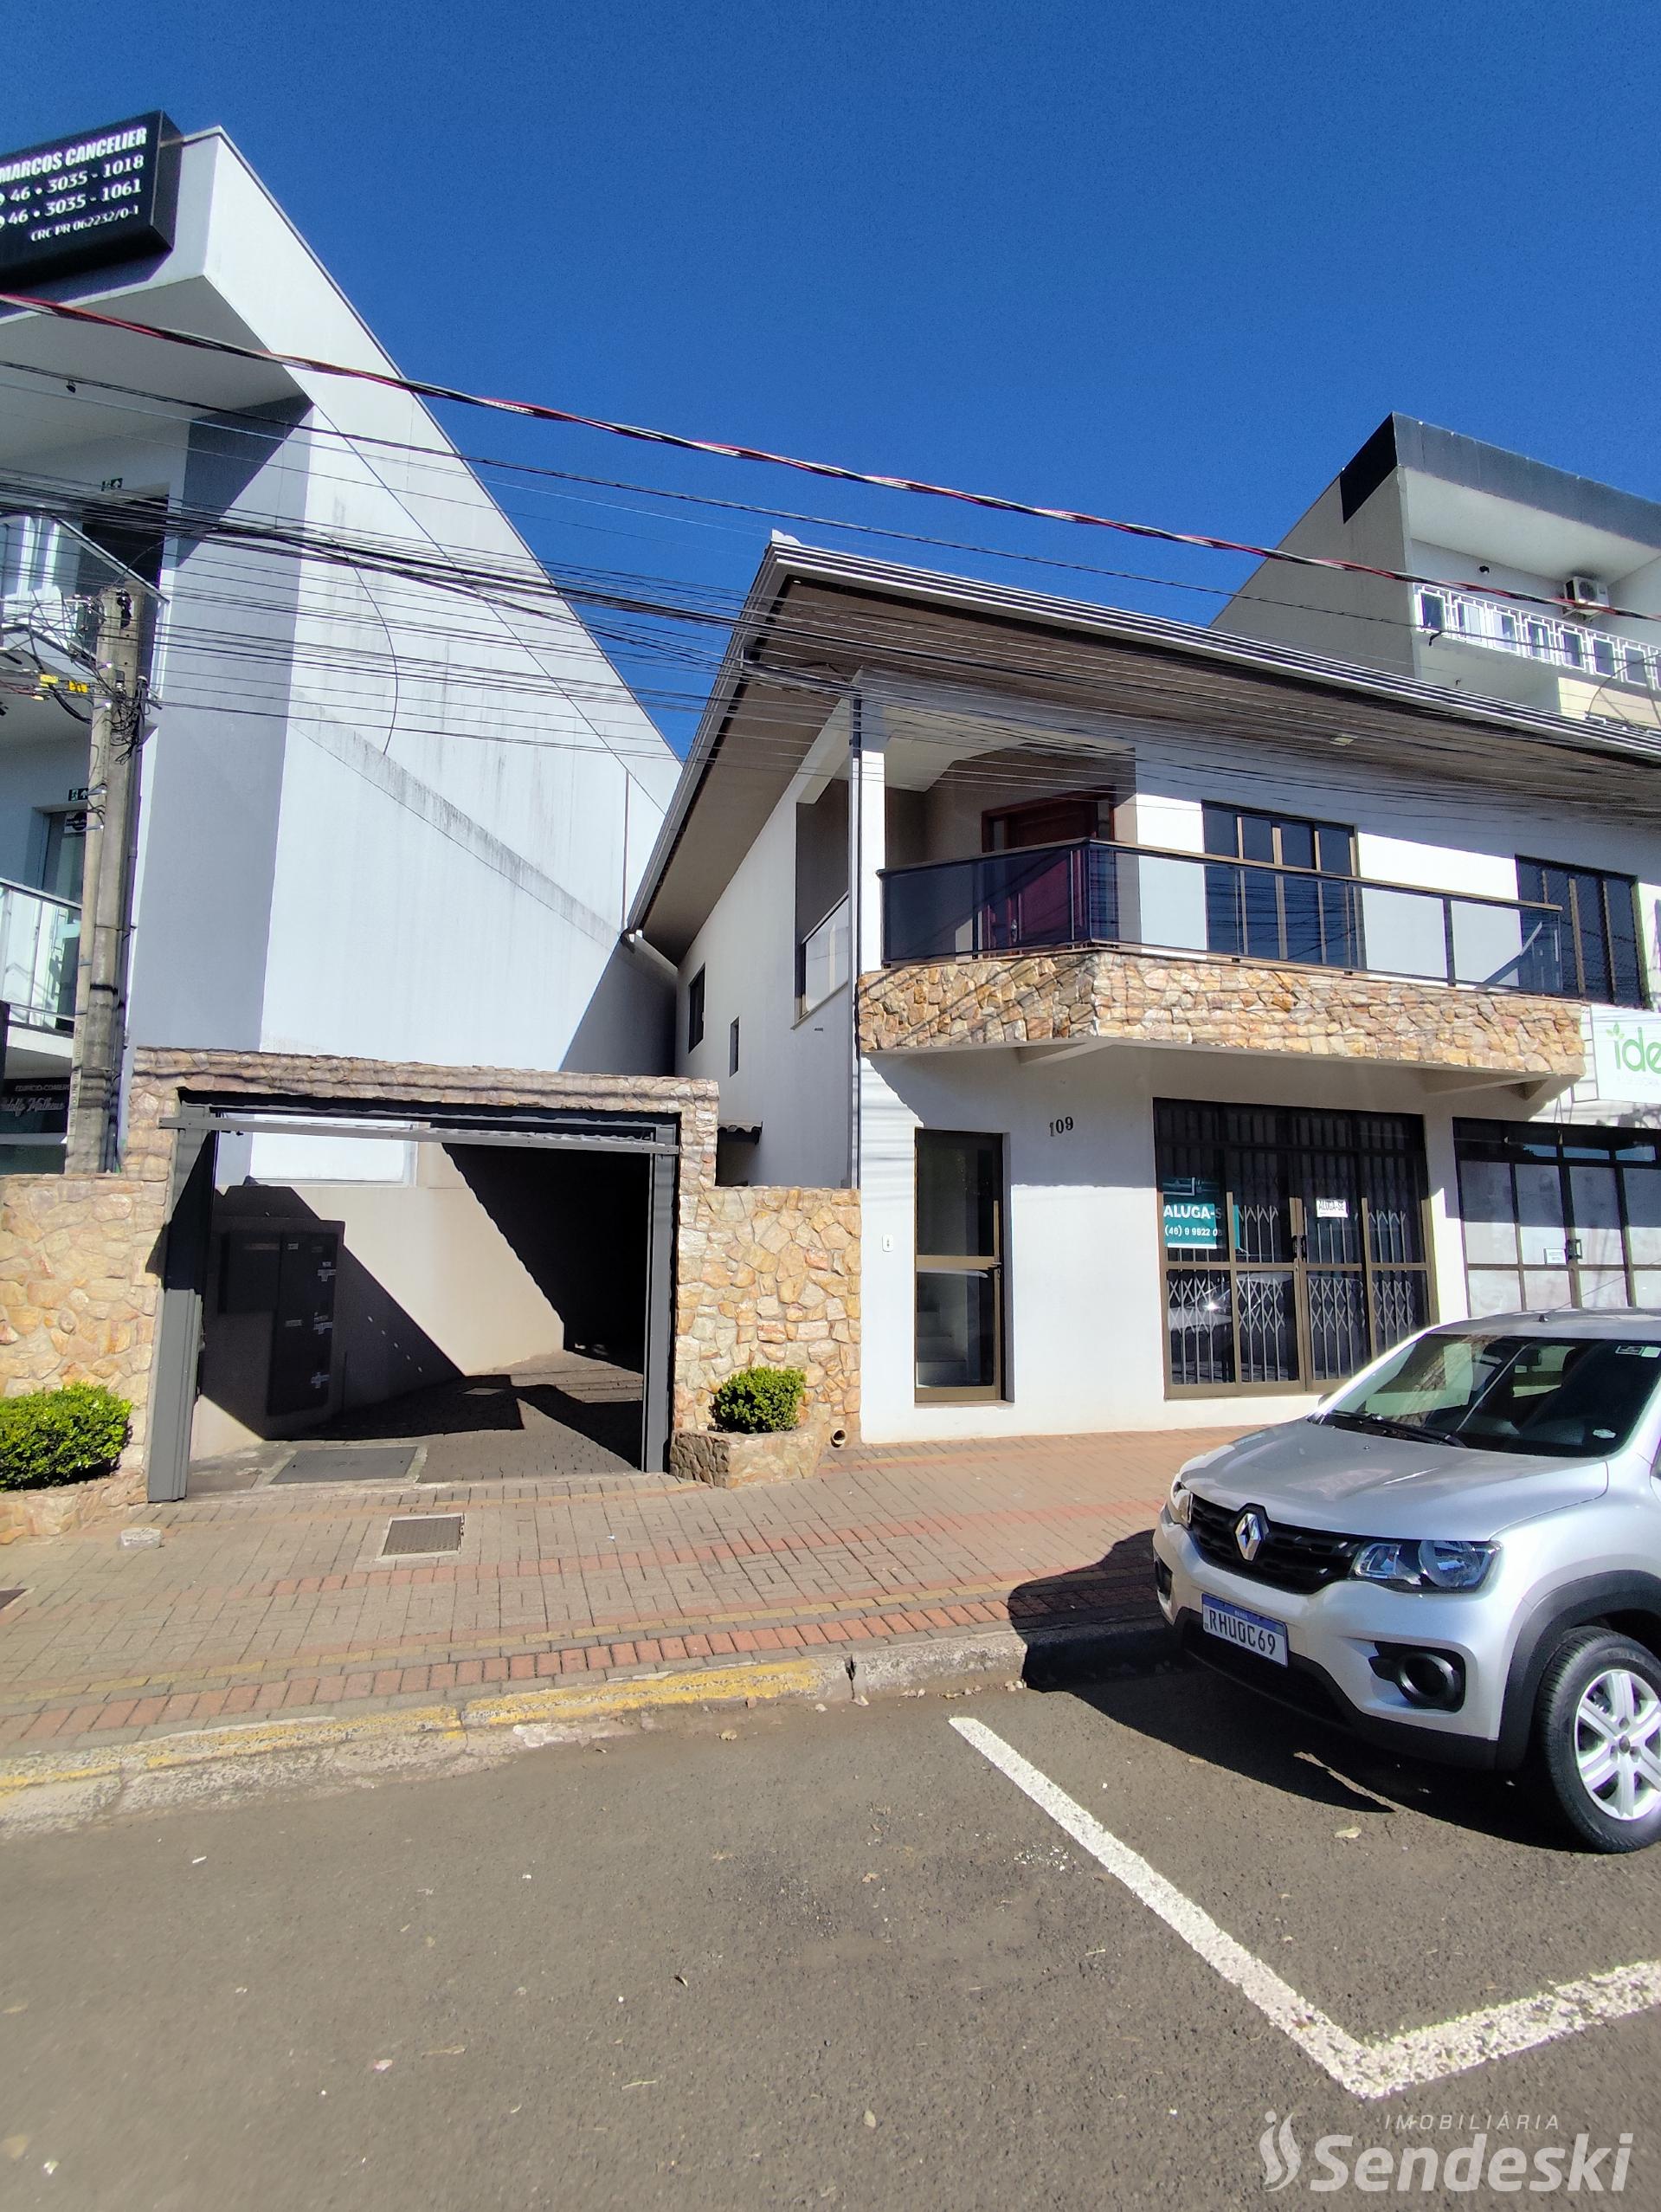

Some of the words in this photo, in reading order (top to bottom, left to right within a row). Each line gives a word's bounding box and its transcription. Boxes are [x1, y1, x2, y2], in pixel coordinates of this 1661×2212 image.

[0, 152, 63, 184] MARCOS
[65, 127, 147, 166] CANCELIER
[10, 186, 31, 202] 46
[47, 171, 88, 194] 3035
[102, 155, 145, 178] 1018
[8, 209, 29, 225] 46
[45, 194, 87, 216] 3035
[100, 178, 141, 202] 1061
[1049, 1116, 1074, 1137] 109
[1163, 1204, 1222, 1219] ALUGA-S
[1164, 1224, 1182, 1236] (46)
